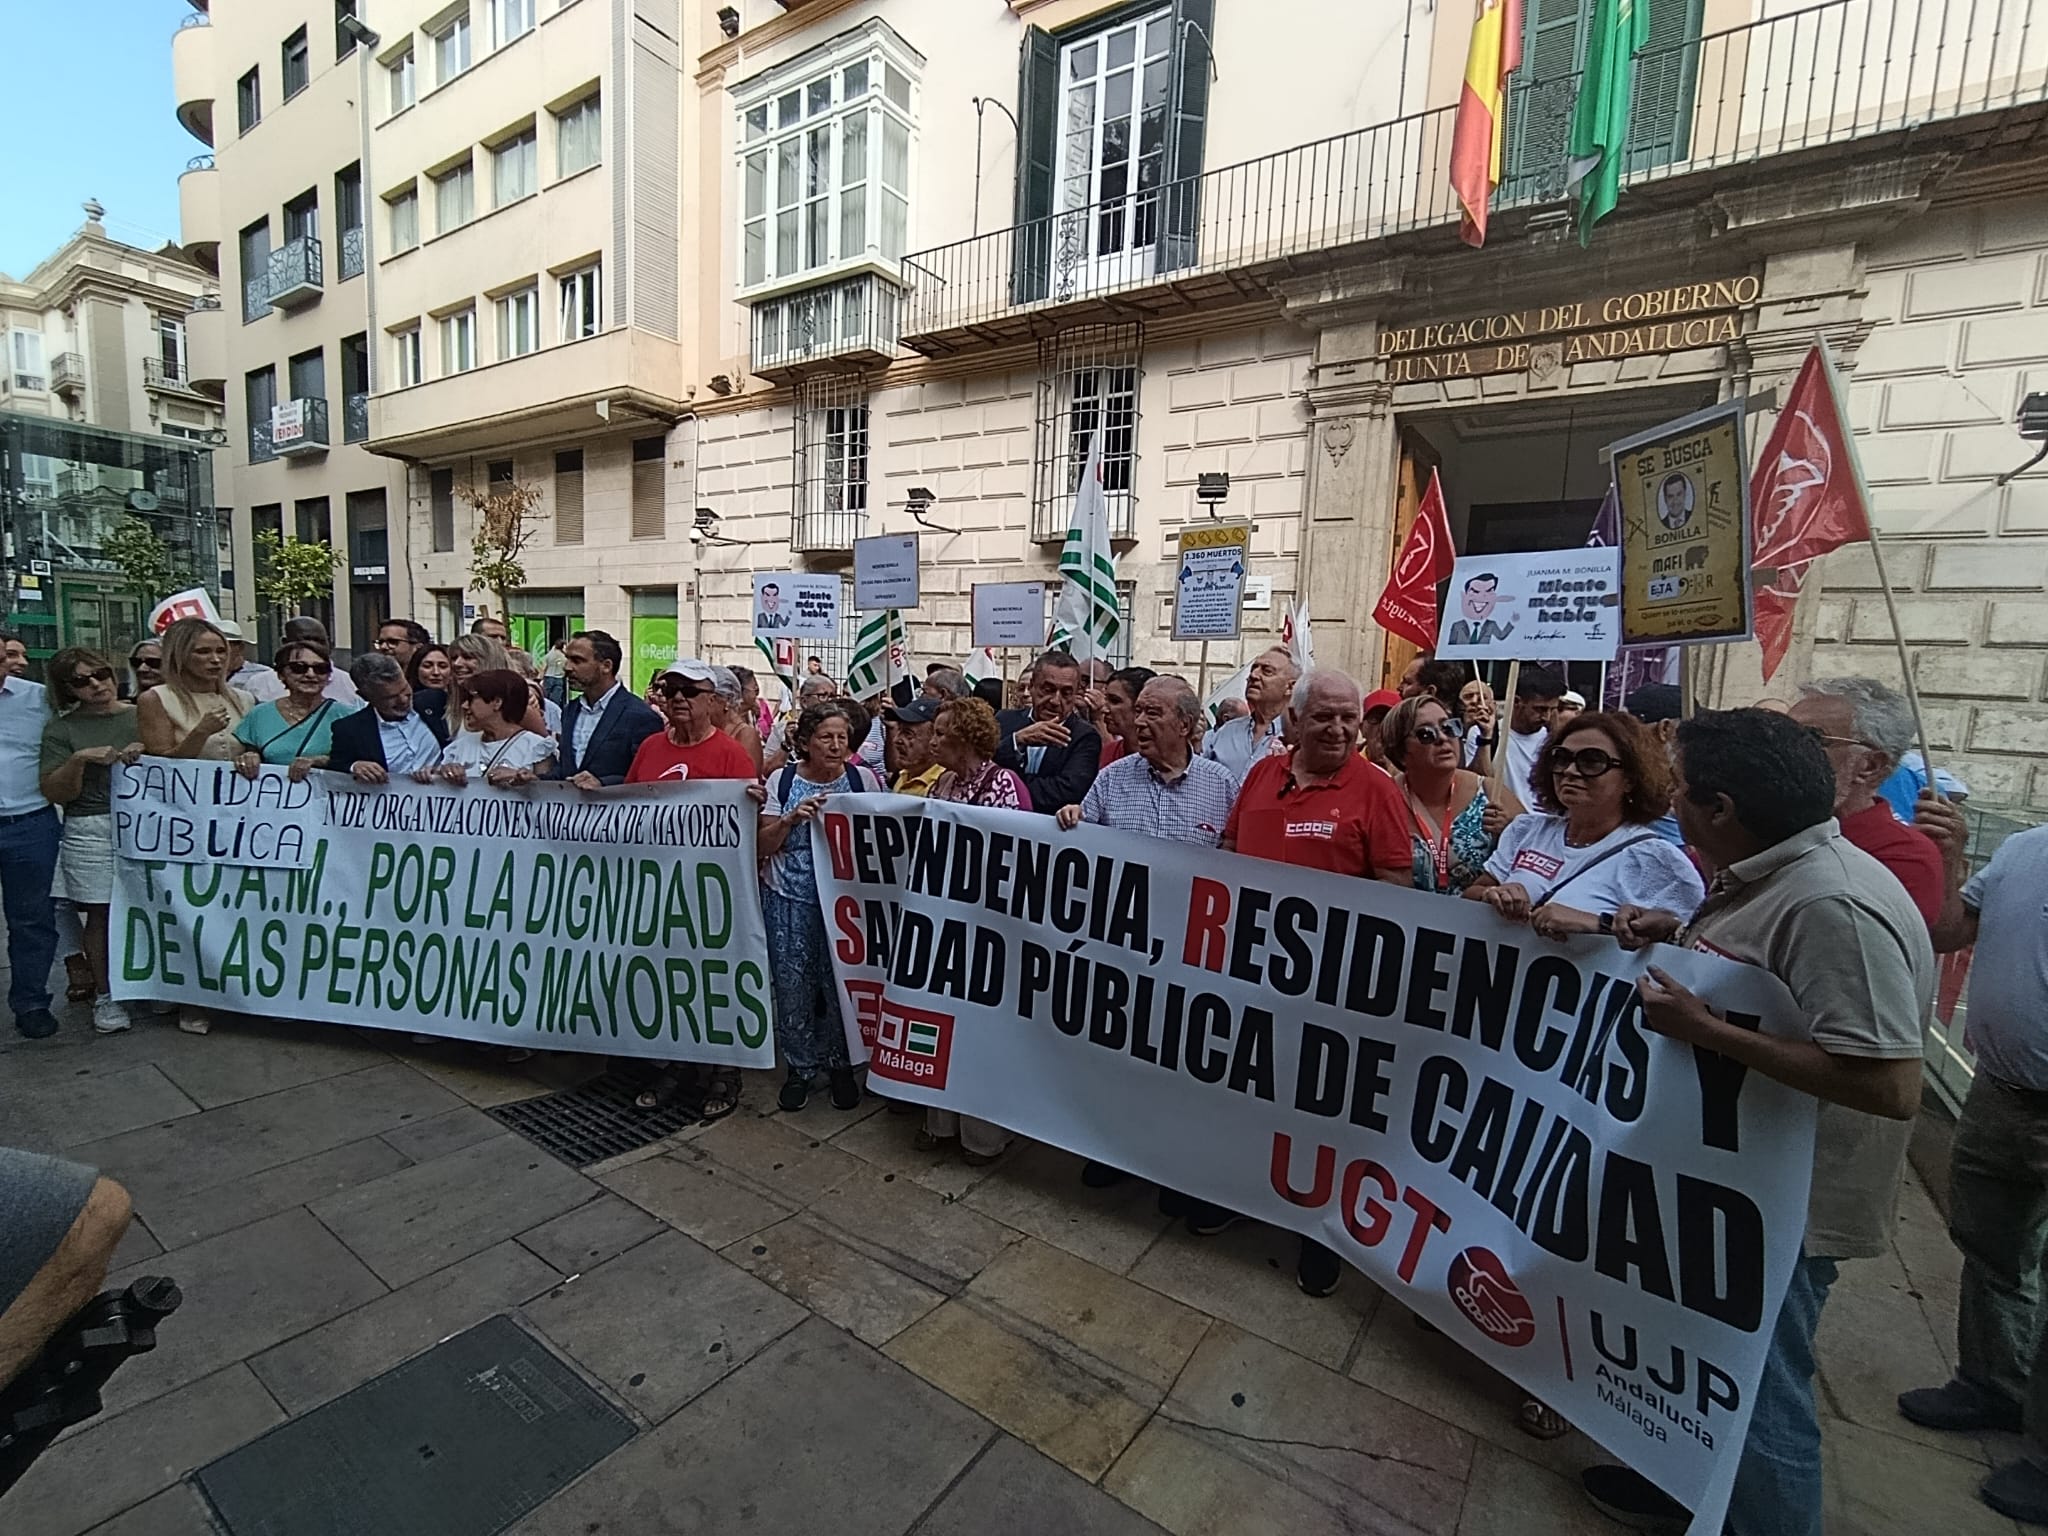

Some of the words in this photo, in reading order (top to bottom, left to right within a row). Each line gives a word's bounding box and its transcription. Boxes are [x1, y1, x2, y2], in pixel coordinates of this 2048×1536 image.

[1379, 311, 1528, 355] DELEGACION
[1536, 303, 1591, 332] DEL
[1602, 275, 1760, 322] GOBIERNO
[1389, 352, 1471, 383] JUNTA
[1496, 343, 1530, 370] DE
[1565, 315, 1738, 362] ANDALUCIA
[1637, 455, 1656, 477] SE
[1663, 436, 1713, 470] BUSCA
[1654, 525, 1702, 546] BONILLA
[1184, 551, 1205, 560] 3.360
[1206, 548, 1242, 559] MUERTOS
[1652, 554, 1683, 574] MAFI
[1527, 568, 1561, 578] JUANMA
[1574, 565, 1612, 575] BONILLA
[799, 590, 832, 600] Miente
[1214, 583, 1234, 591] Bonilla
[1537, 578, 1607, 594] Miente
[795, 600, 815, 609] más
[816, 601, 835, 610] que
[800, 608, 829, 618] habla
[1528, 594, 1569, 609] más
[1537, 608, 1597, 623] habla
[342, 791, 371, 829] DE
[372, 793, 532, 839] ORGANIZACIONES
[532, 801, 619, 845] ANDALUZAS
[618, 804, 649, 846] DE
[648, 802, 741, 849] MAYORES
[365, 842, 456, 926] POR
[464, 848, 515, 933] LA
[525, 852, 732, 950] DIGNIDAD
[123, 906, 185, 986] DE
[192, 914, 287, 998] LAS
[298, 922, 531, 1028] PERSONAS
[536, 945, 768, 1050] MAYORES
[879, 1048, 935, 1077] Málaga
[1017, 938, 1276, 1103] PÚBLICA
[1295, 1020, 1397, 1135] DE
[1410, 1054, 1765, 1335] CALIDAD
[1269, 1131, 1452, 1284] UGT
[1590, 1309, 1740, 1417] UJP
[1596, 1383, 1668, 1443] Málaga
